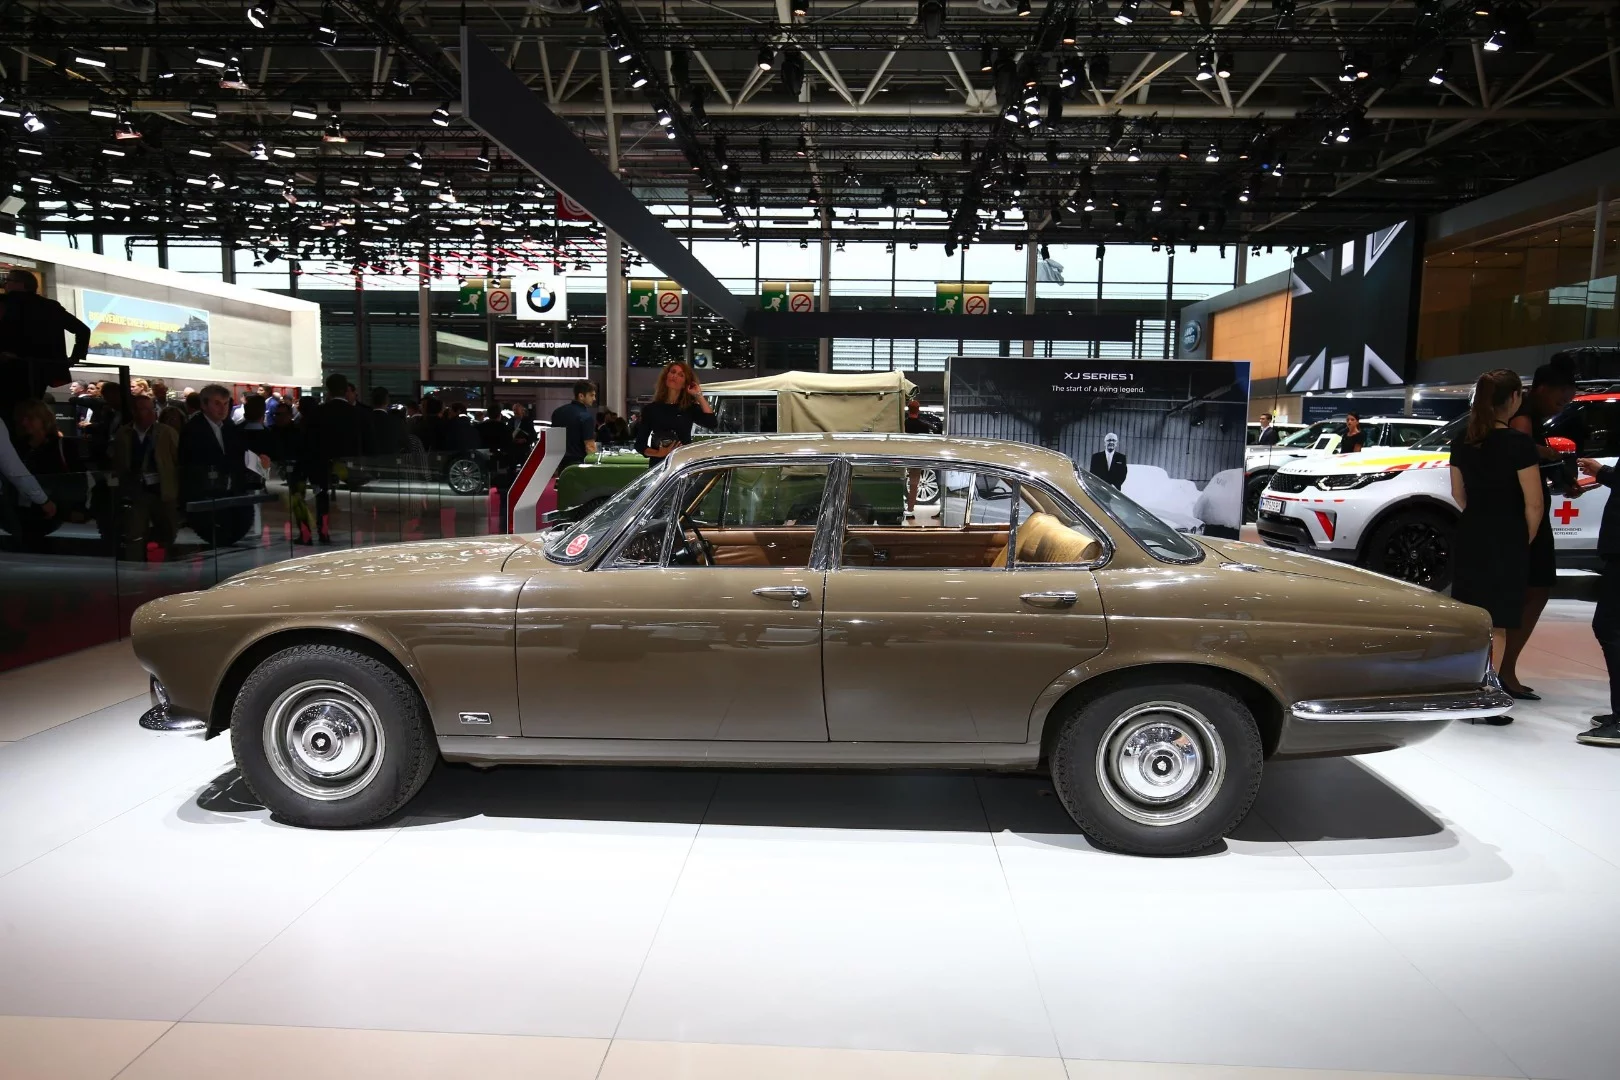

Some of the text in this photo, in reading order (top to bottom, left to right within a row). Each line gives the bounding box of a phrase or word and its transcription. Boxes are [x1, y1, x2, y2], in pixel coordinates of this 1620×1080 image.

[537, 356, 580, 368] TOWN
[1064, 372, 1134, 381] XJ SERIES 1
